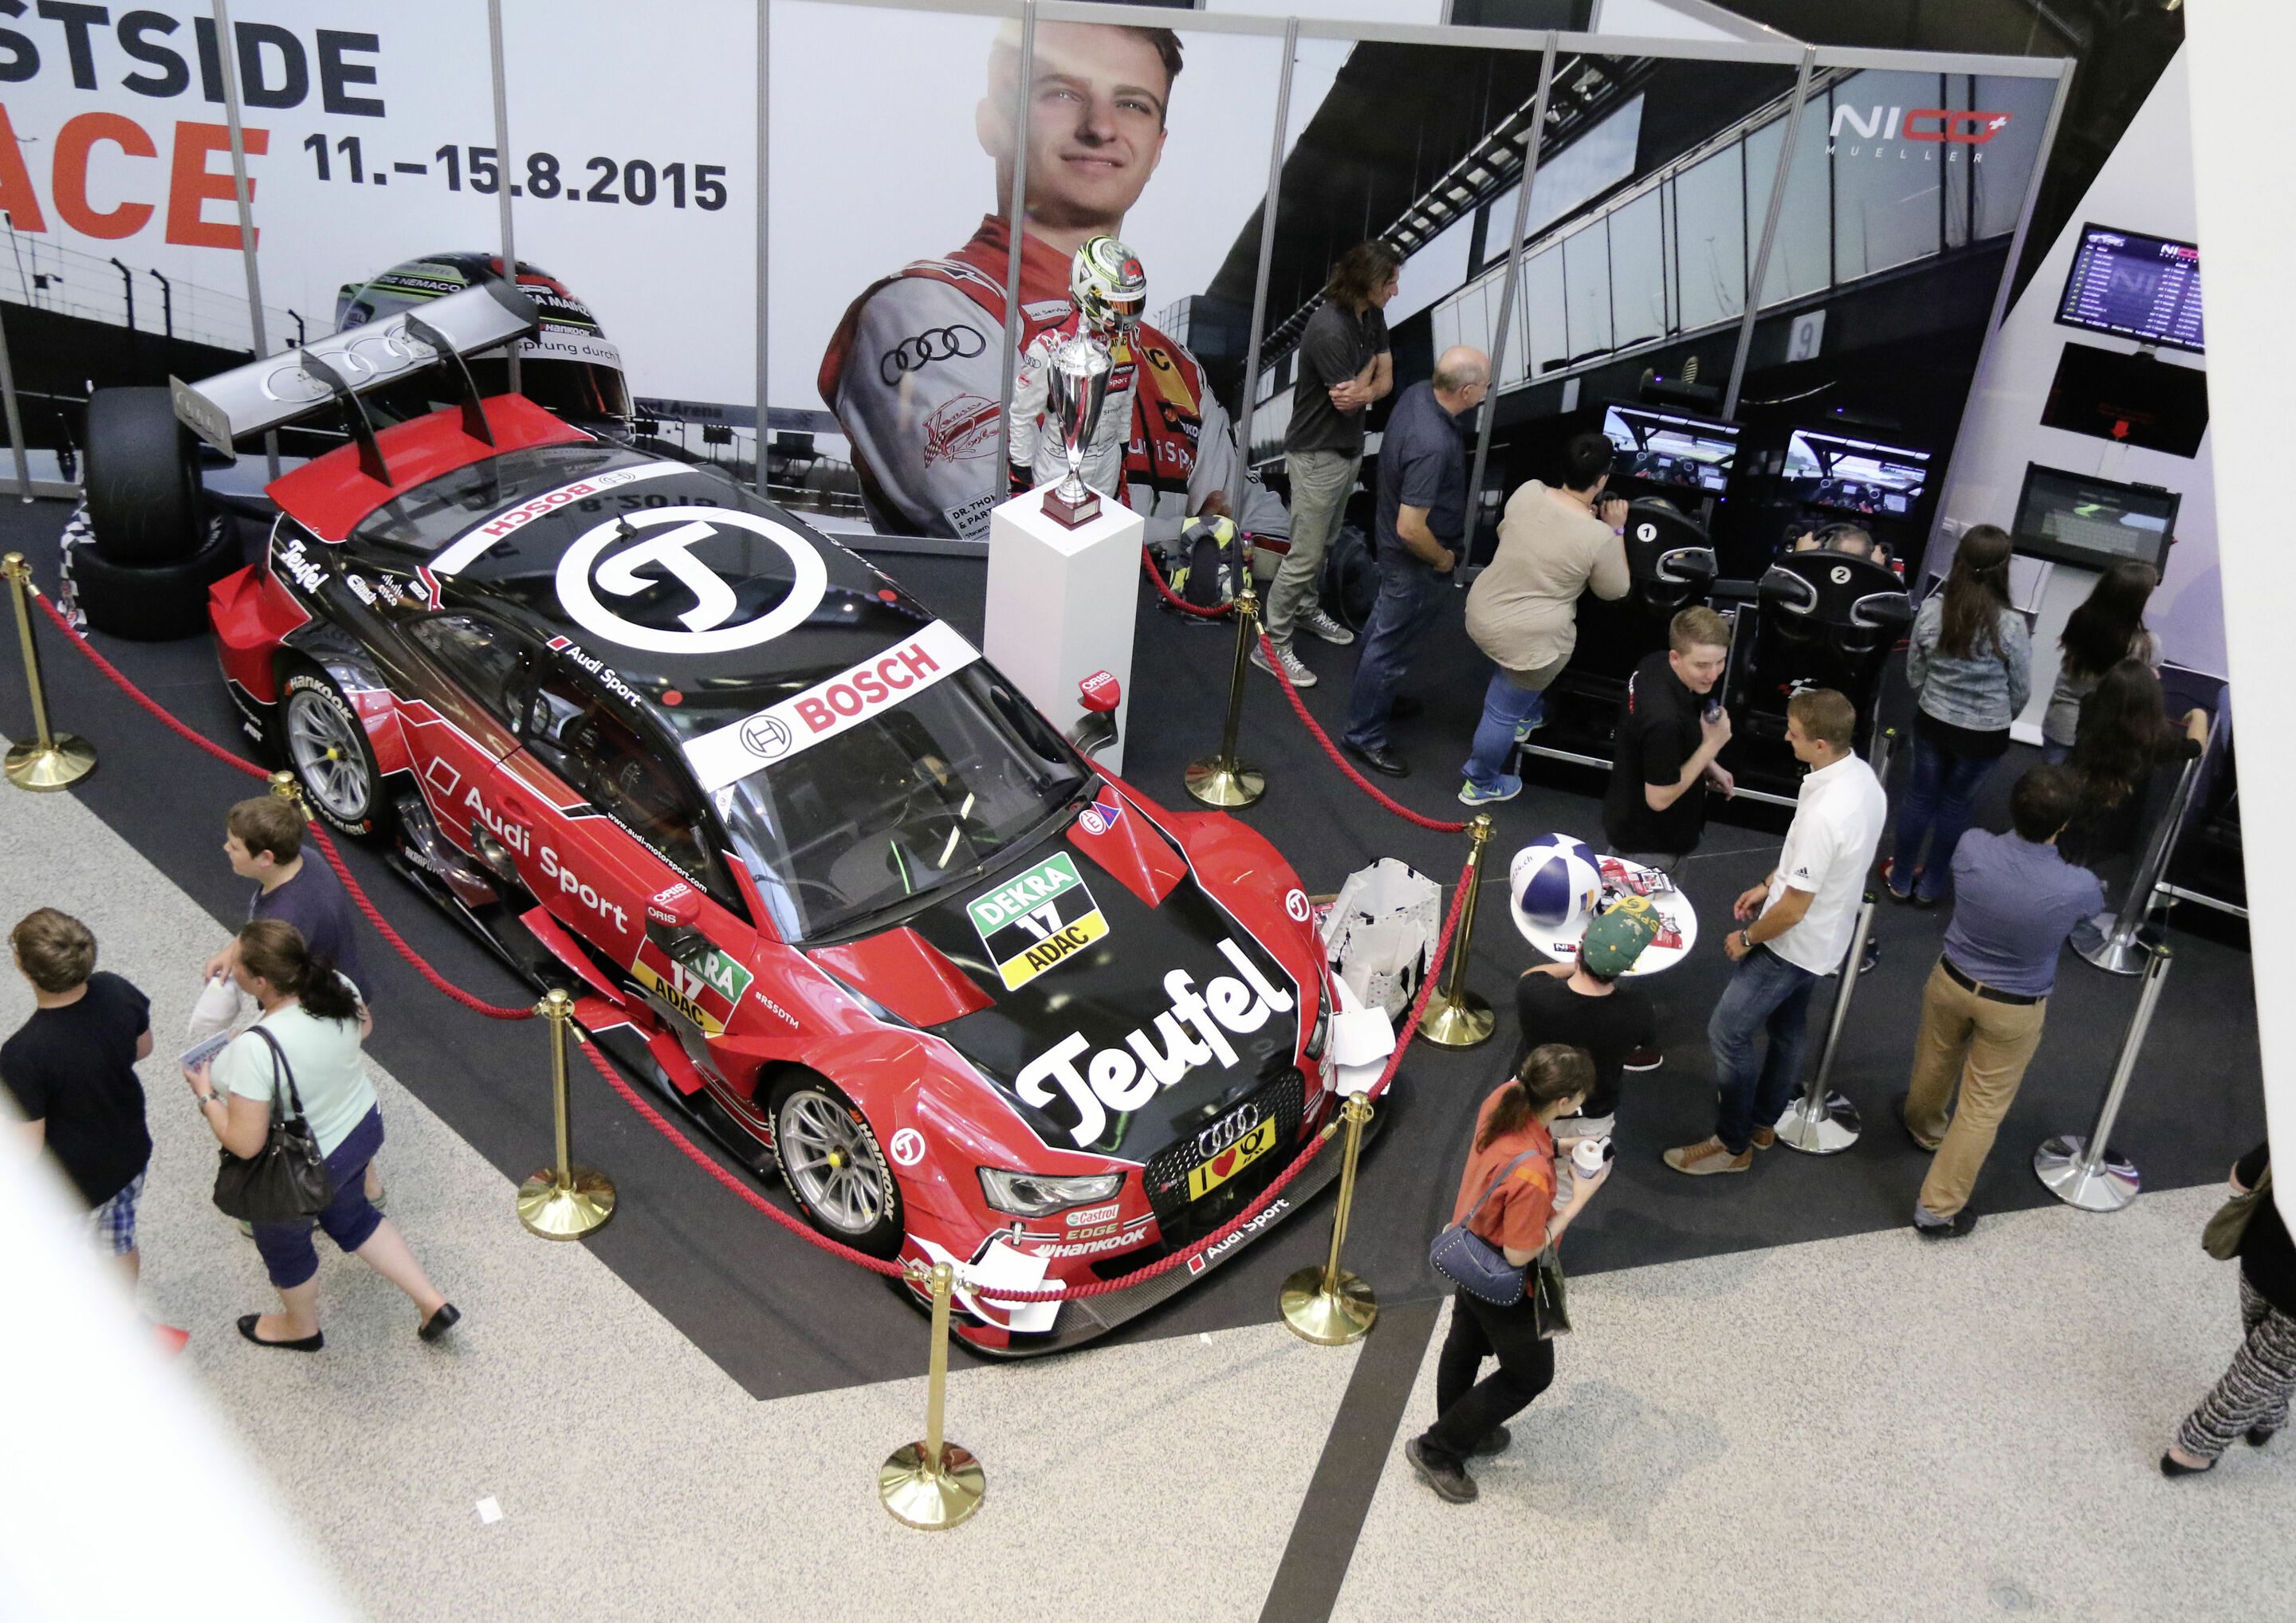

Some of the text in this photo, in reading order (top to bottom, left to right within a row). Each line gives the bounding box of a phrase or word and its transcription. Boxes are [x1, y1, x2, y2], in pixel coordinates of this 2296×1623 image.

[1830, 104, 2012, 143] NICO
[1825, 145, 1983, 163] MUELLER
[399, 277, 461, 293] NEMACO
[550, 297, 590, 316] MAINZ
[1799, 322, 1814, 361] 9
[482, 484, 596, 536] BOSCH
[953, 507, 970, 520] DR.
[1643, 528, 1650, 538] 1
[279, 539, 329, 594] Teufel
[1836, 570, 1846, 580] 2
[565, 646, 641, 707] Audi Sport
[794, 643, 939, 733] BOSCH
[1082, 672, 1111, 689] ORIS
[466, 788, 628, 934] Audi Sport
[607, 812, 707, 893] www.audi-motorsport.com
[653, 882, 688, 902] ORIS
[980, 864, 1074, 927] DEKRA
[647, 906, 677, 923] ORIS
[1015, 902, 1065, 942] 17
[1025, 925, 1089, 973] ADAC
[671, 960, 705, 1001] 17
[655, 977, 704, 1026] ADAC
[1016, 937, 1293, 1148] Teufel
[1066, 1223, 1119, 1240] EDGE
[1079, 1207, 1117, 1224] Castrol
[1206, 1198, 1290, 1259] Audi Sport
